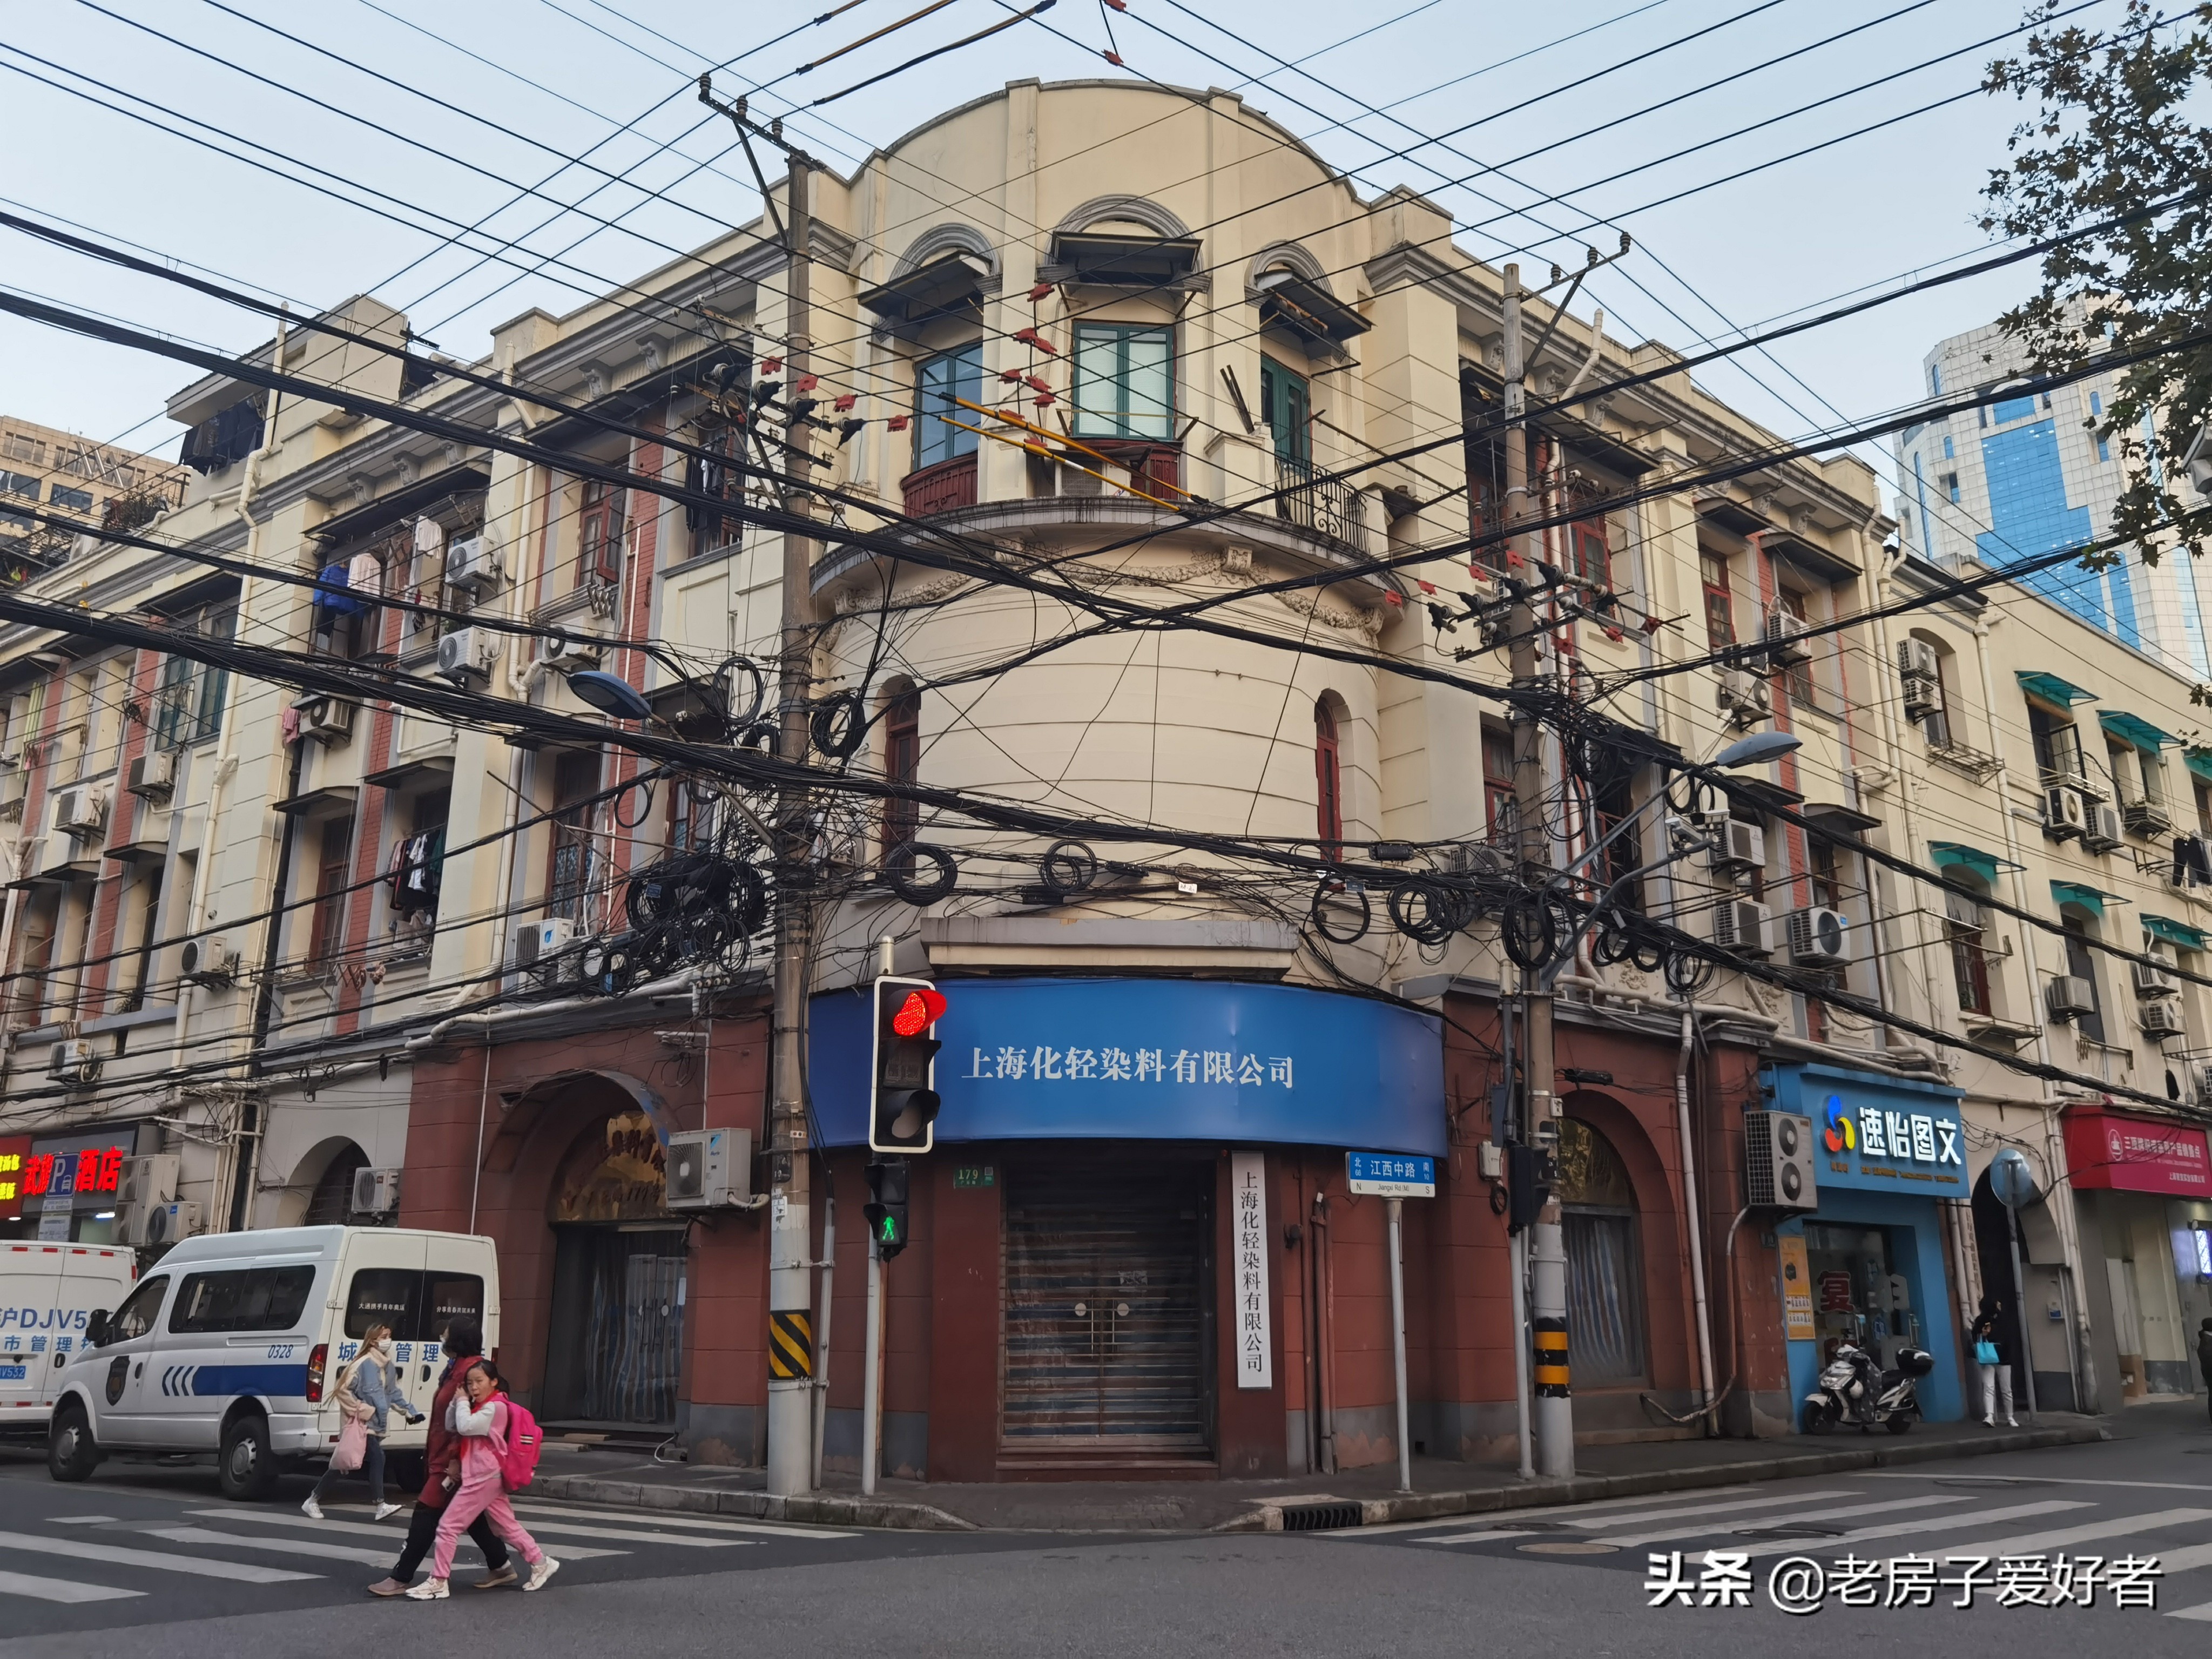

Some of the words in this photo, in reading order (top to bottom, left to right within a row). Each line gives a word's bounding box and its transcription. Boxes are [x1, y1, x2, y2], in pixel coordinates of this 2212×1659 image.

[962, 1046, 1293, 1088] 上海化轻染料有限公司
[1859, 1107, 1961, 1164] 速怡图文
[1355, 1157, 1361, 1168] 北
[1370, 1160, 1415, 1178] 江西中路
[1423, 1162, 1429, 1172] 南
[959, 1169, 979, 1179] 179
[1356, 1183, 1361, 1191] N
[1378, 1184, 1393, 1192] Jiangxi
[1240, 1171, 1263, 1373] 上海化轻染料有限公司
[268, 1344, 294, 1359] 0328
